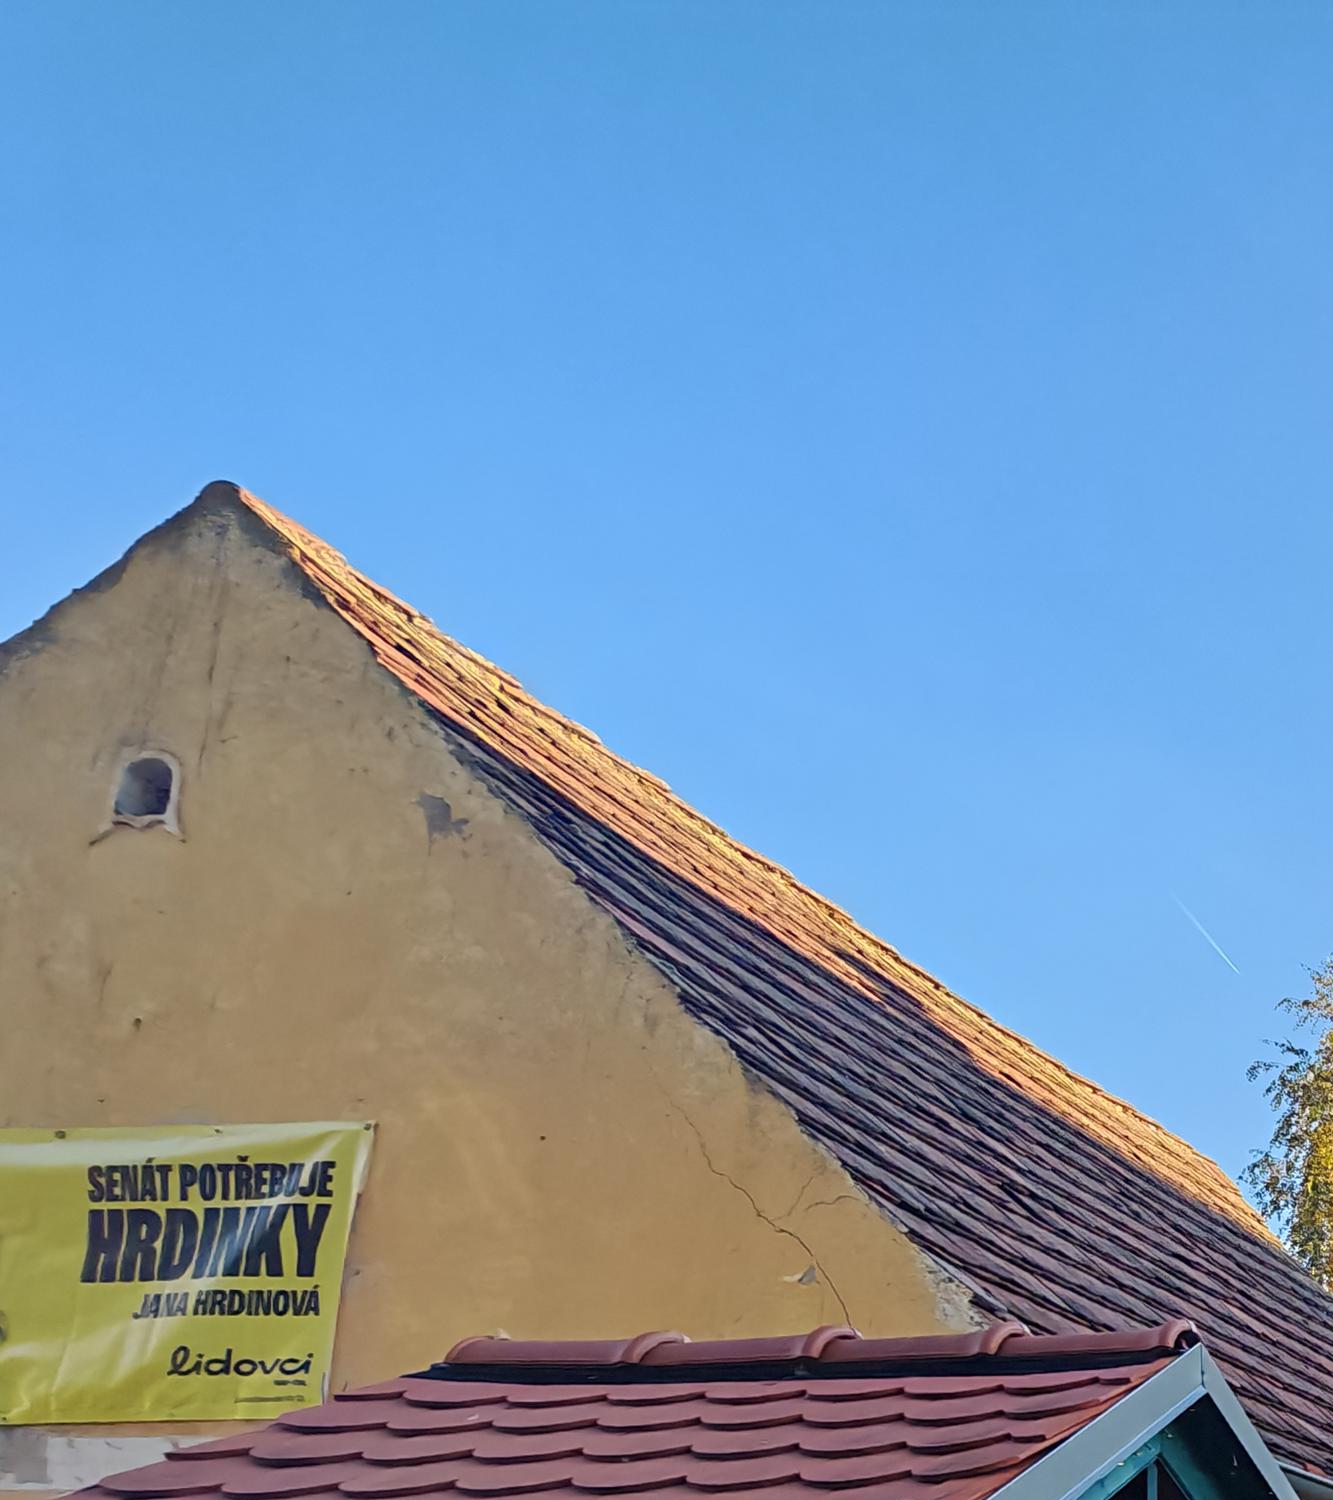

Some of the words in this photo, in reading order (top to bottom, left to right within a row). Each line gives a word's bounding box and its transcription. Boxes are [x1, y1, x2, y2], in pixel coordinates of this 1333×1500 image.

[87, 1158, 172, 1203] SENÁT
[179, 1155, 336, 1202] POTŘEBUJE
[80, 1204, 332, 1283] HRDINKY
[132, 1292, 188, 1319] JANA
[192, 1284, 321, 1317] HRDINOVÁ
[166, 1345, 314, 1376] lidovci
